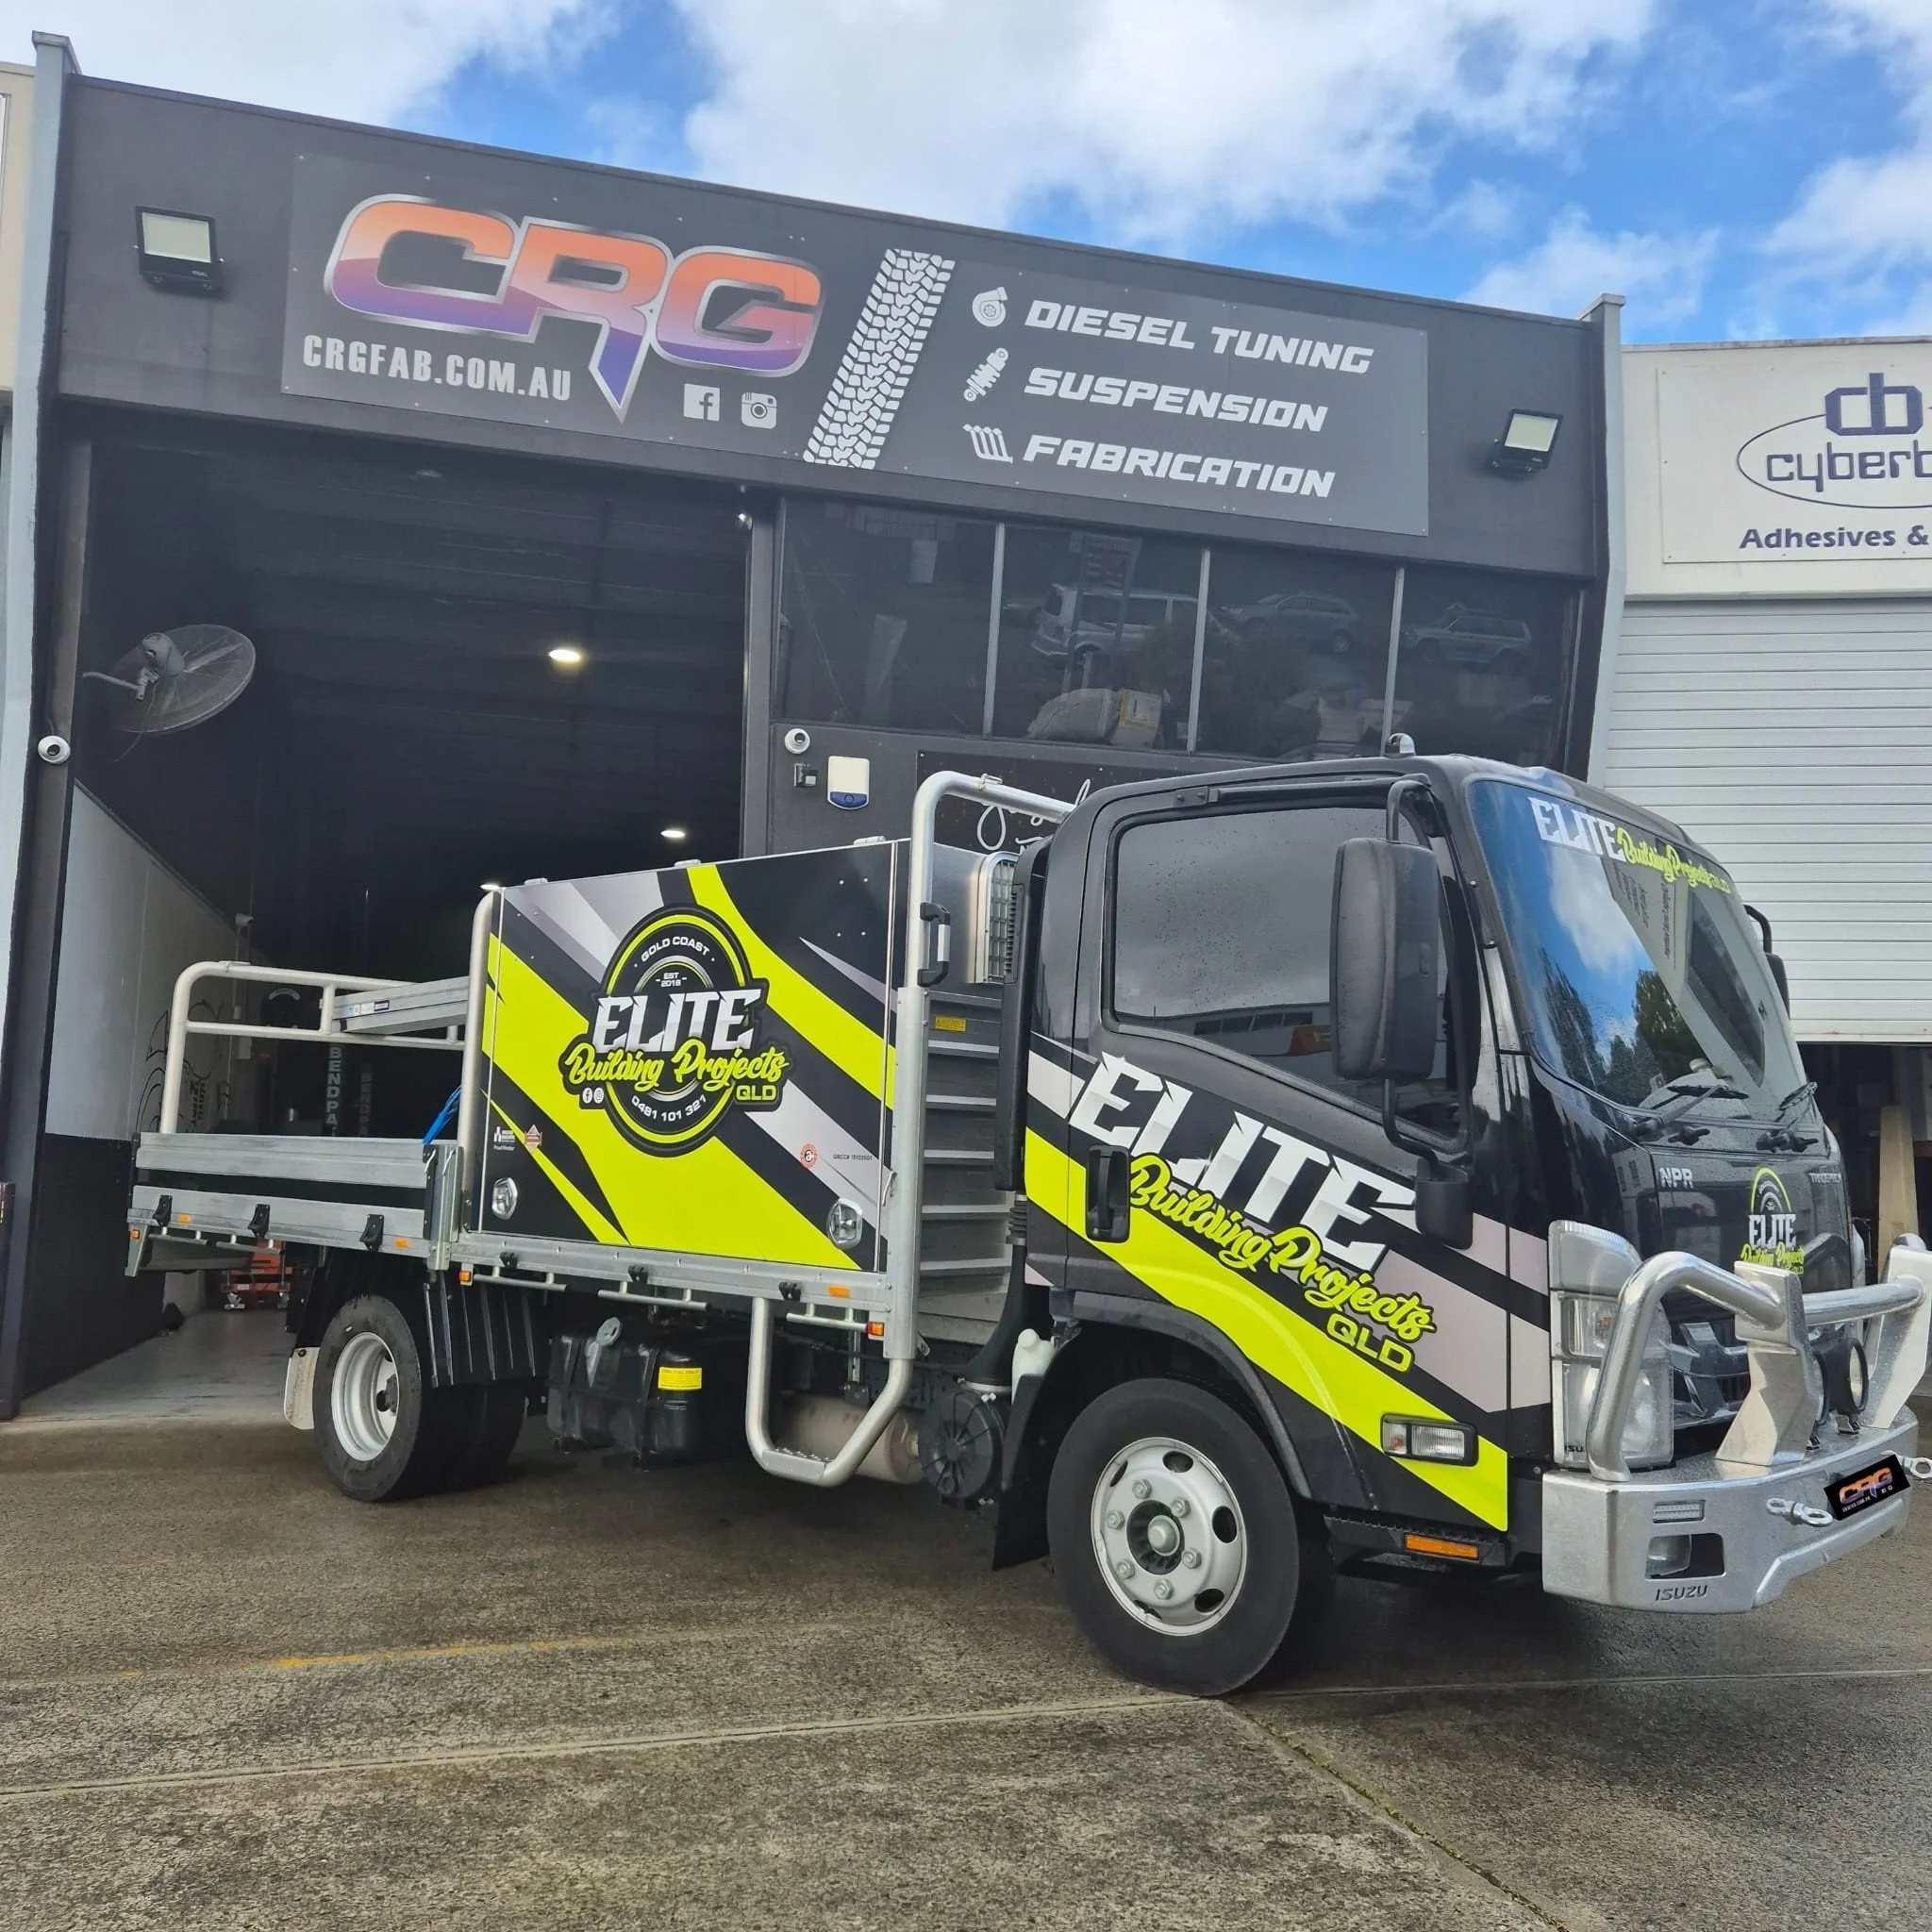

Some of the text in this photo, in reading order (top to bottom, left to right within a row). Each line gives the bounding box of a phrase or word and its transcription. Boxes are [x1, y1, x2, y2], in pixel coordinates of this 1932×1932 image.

[324, 193, 823, 424] CRG
[1024, 300, 1374, 375] DIESEL TUNING
[303, 334, 572, 402] CRGFAB.COM.AU
[1024, 367, 1328, 432] SUSPENSION
[1023, 434, 1336, 498] FABRICATION
[1739, 525, 1929, 549] Adhesives &
[1528, 796, 1627, 863] ELITE
[641, 936, 710, 962] GOLD COAST
[591, 988, 762, 1053] ELITE
[563, 1038, 789, 1092] Building Projects
[736, 1084, 777, 1101] QLD
[631, 1093, 707, 1123] 0481 101 321
[1067, 1050, 1423, 1273] ELITE
[1659, 1167, 1694, 1190] NPR
[1129, 1153, 1437, 1343] Building Projects
[1748, 1213, 1797, 1250] ELITE
[1325, 1312, 1415, 1373] QLD
[1564, 1444, 1586, 1453] ISU
[1655, 1584, 1708, 1602] ISUZU
